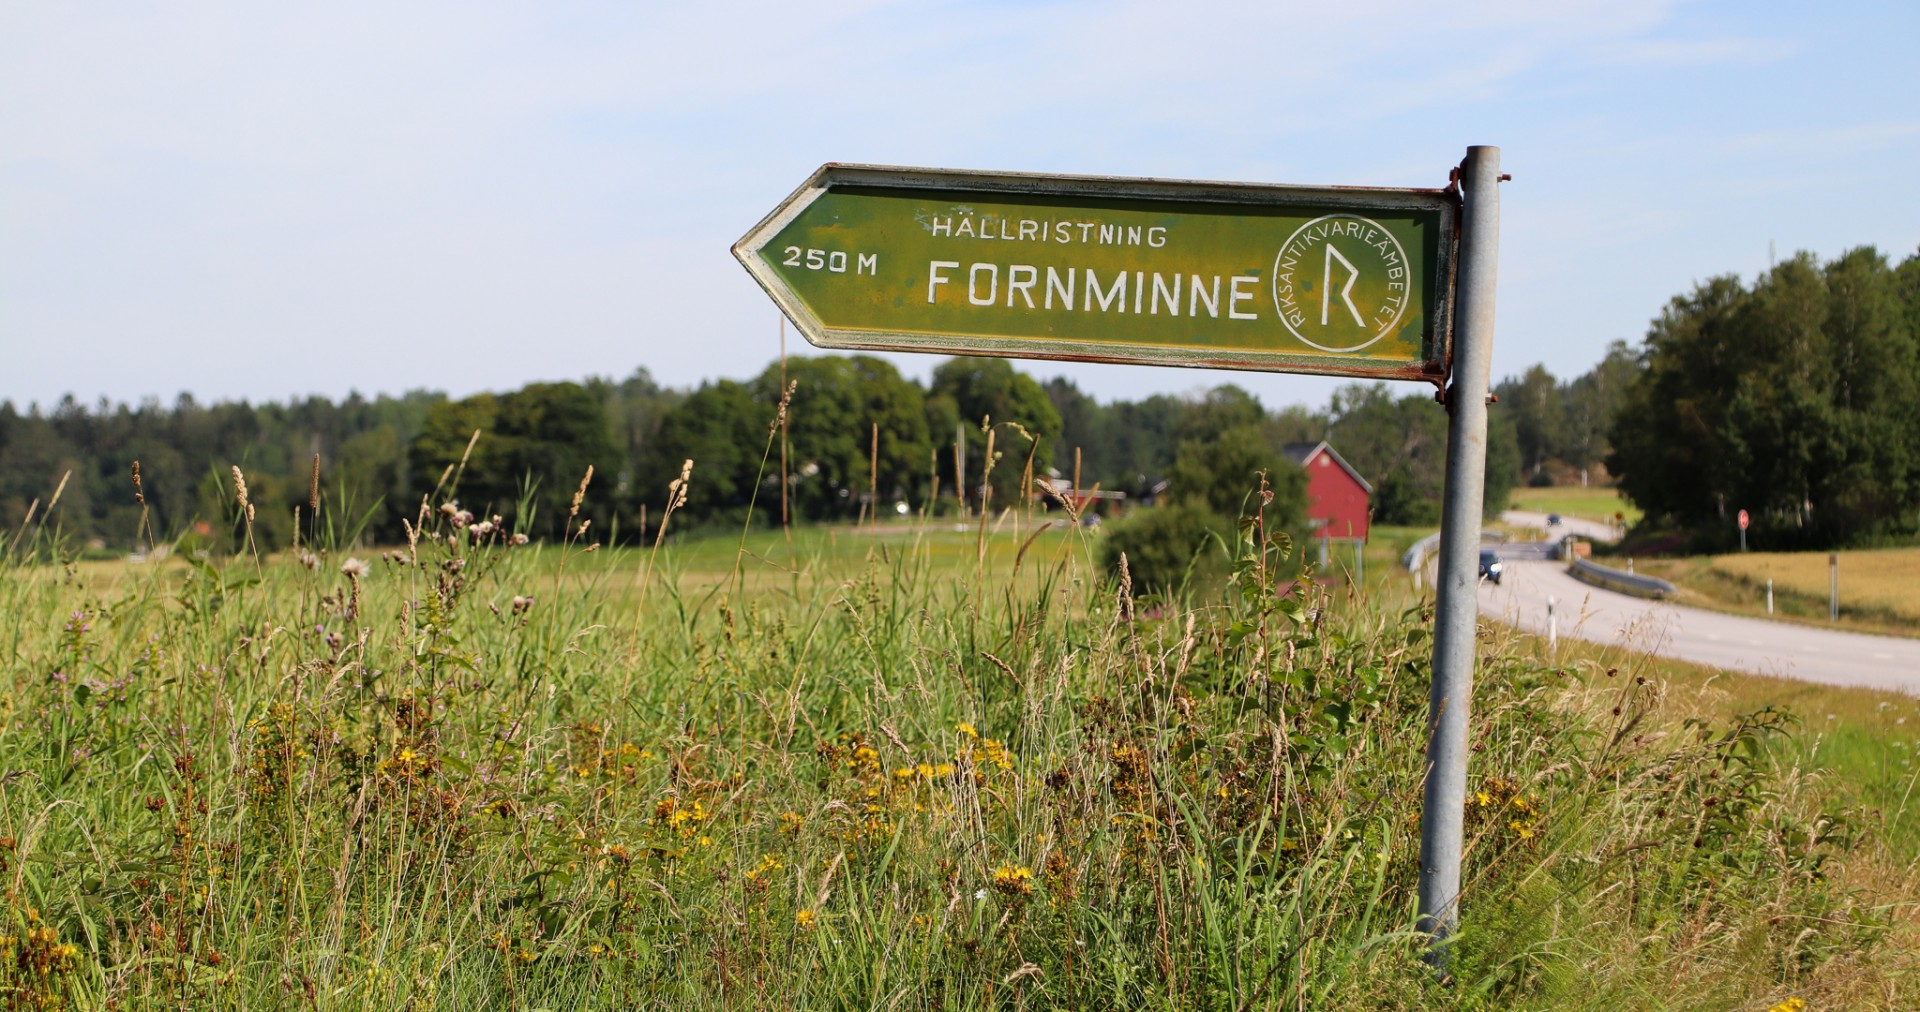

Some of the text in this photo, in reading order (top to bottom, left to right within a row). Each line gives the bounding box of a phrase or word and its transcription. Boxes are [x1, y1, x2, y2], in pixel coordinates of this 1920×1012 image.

[932, 211, 1167, 247] HÄLLRISTNING
[782, 246, 878, 276] 250 M
[1279, 221, 1404, 331] RIKSANTIKVARIEÄMBETET
[928, 260, 1259, 320] FORNMINNE
